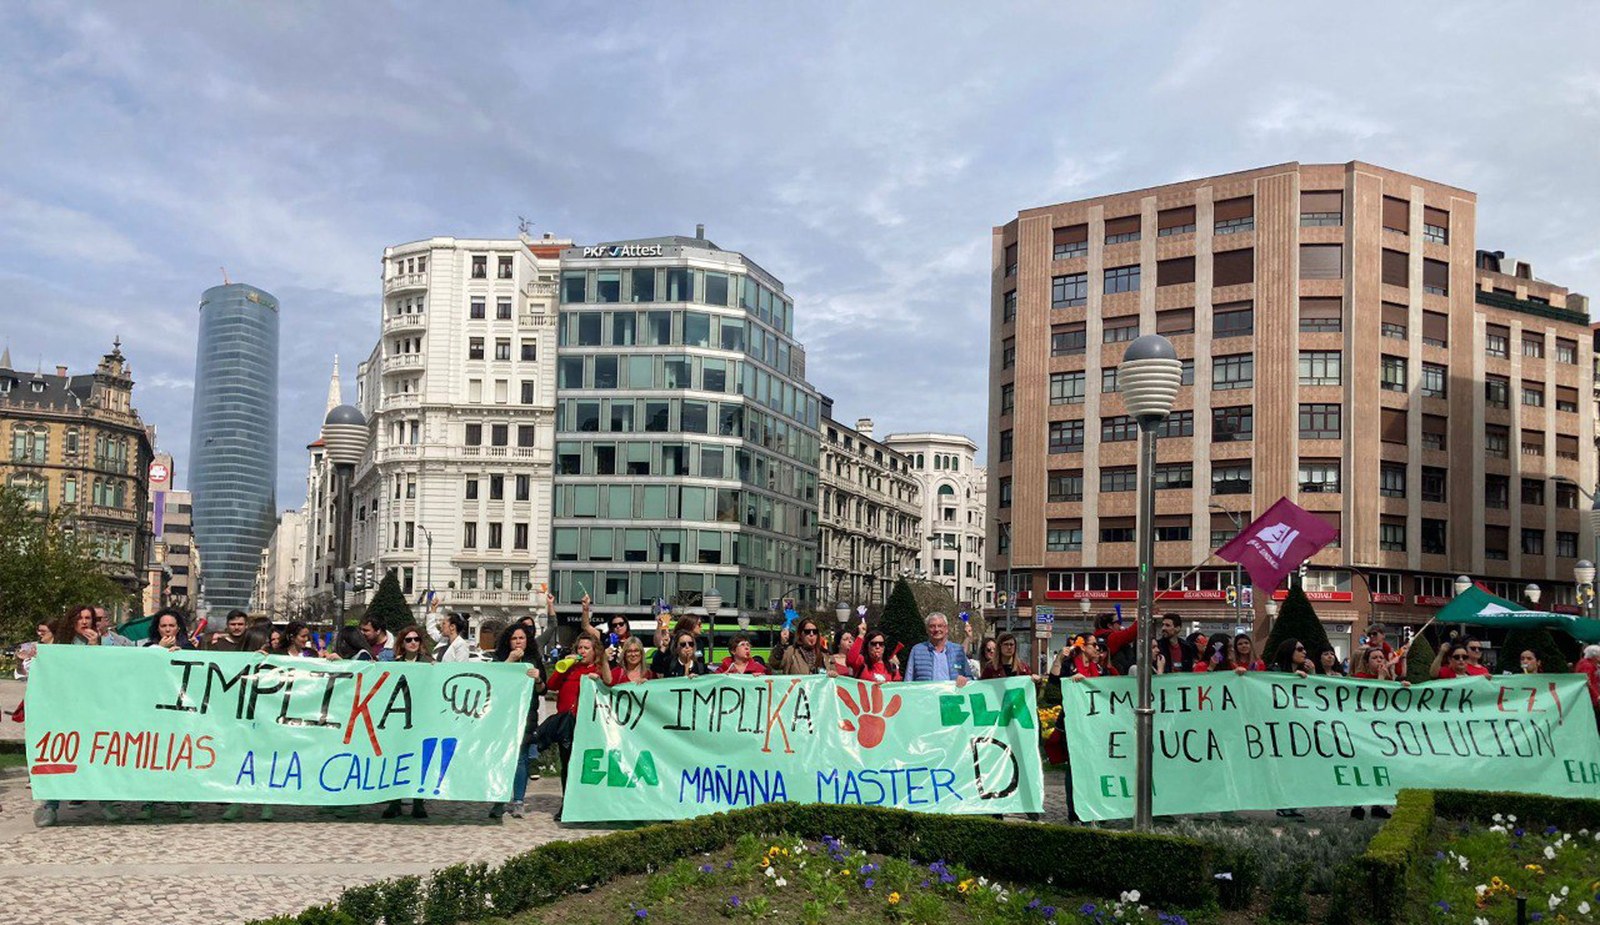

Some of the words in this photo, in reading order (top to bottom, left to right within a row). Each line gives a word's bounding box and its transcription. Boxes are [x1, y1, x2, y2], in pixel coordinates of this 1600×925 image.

[583, 246, 607, 257] PKF
[620, 244, 663, 257] Attest
[155, 659, 413, 757] IMPLIKA
[592, 688, 649, 731] HOY
[663, 678, 814, 754] IMPLIKA
[939, 687, 1035, 730] ELA
[1085, 684, 1237, 717] IMLIKA
[1271, 683, 1474, 714] DESPIDORIK
[1496, 682, 1566, 727] EZ!
[34, 730, 80, 764] 100
[89, 730, 216, 772] FAMILIAS
[1108, 728, 1222, 763] EUCA
[1244, 719, 1356, 760] BIDCO
[1370, 717, 1557, 759] SOLUCION
[235, 750, 256, 786] A
[268, 750, 303, 790] LA
[318, 736, 459, 797] CALLE!!
[580, 747, 660, 789] ELA
[678, 764, 788, 806] MAÑANA
[816, 766, 963, 806] MASTER
[970, 736, 1020, 800] D
[1099, 774, 1157, 799] EL
[1333, 765, 1392, 787] ELA
